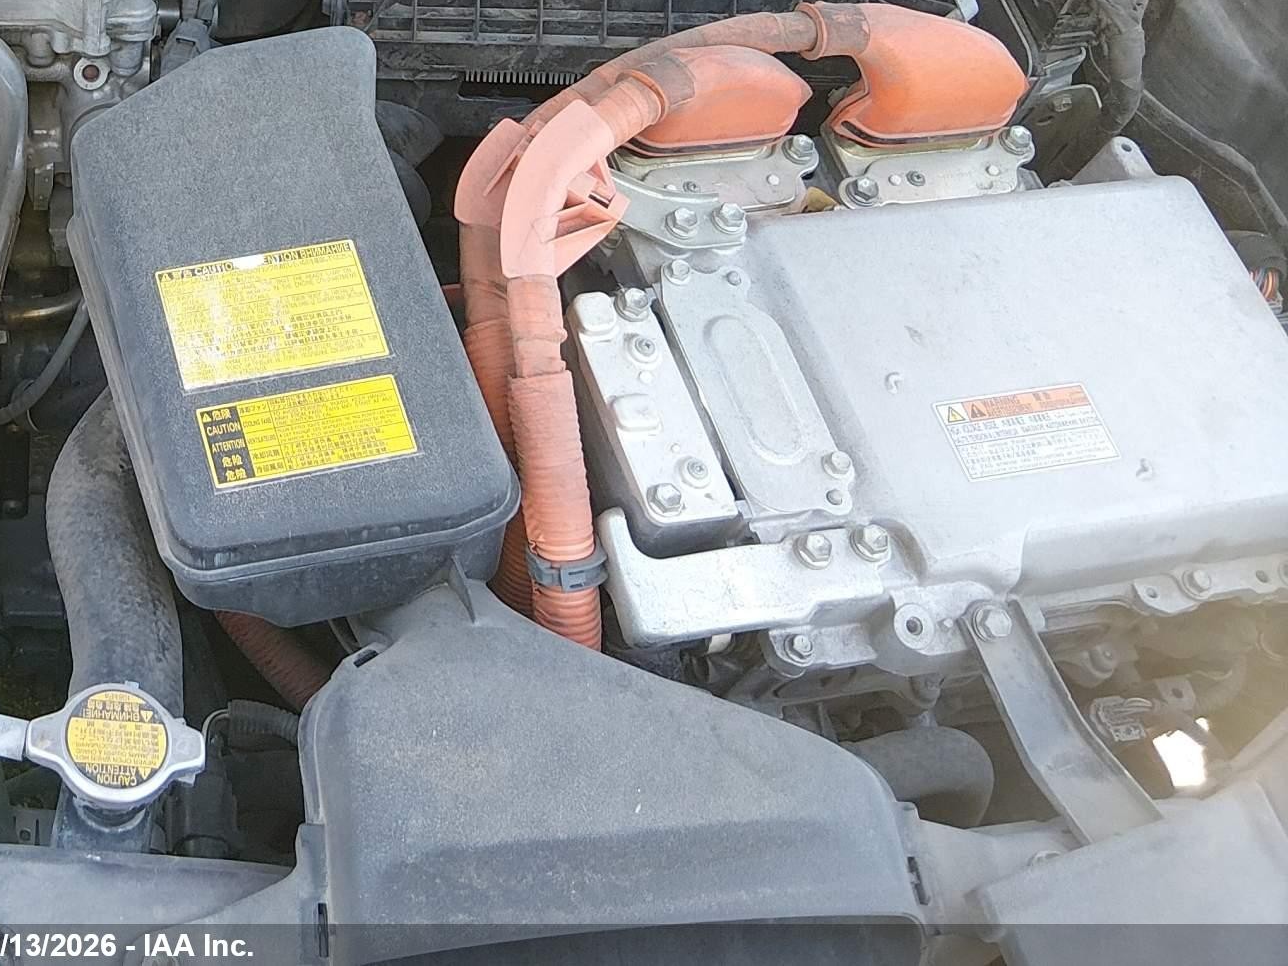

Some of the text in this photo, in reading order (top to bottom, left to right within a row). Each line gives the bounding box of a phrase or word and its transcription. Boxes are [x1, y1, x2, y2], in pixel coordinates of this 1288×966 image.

[195, 261, 236, 276] CAUTIO
[207, 423, 241, 436] CAUTION
[212, 438, 246, 454] ATTENTION
[82, 708, 140, 722] ВНИМАНИЕ!
[85, 763, 137, 776] ATTENTION
[96, 773, 137, 786] CAUTION
